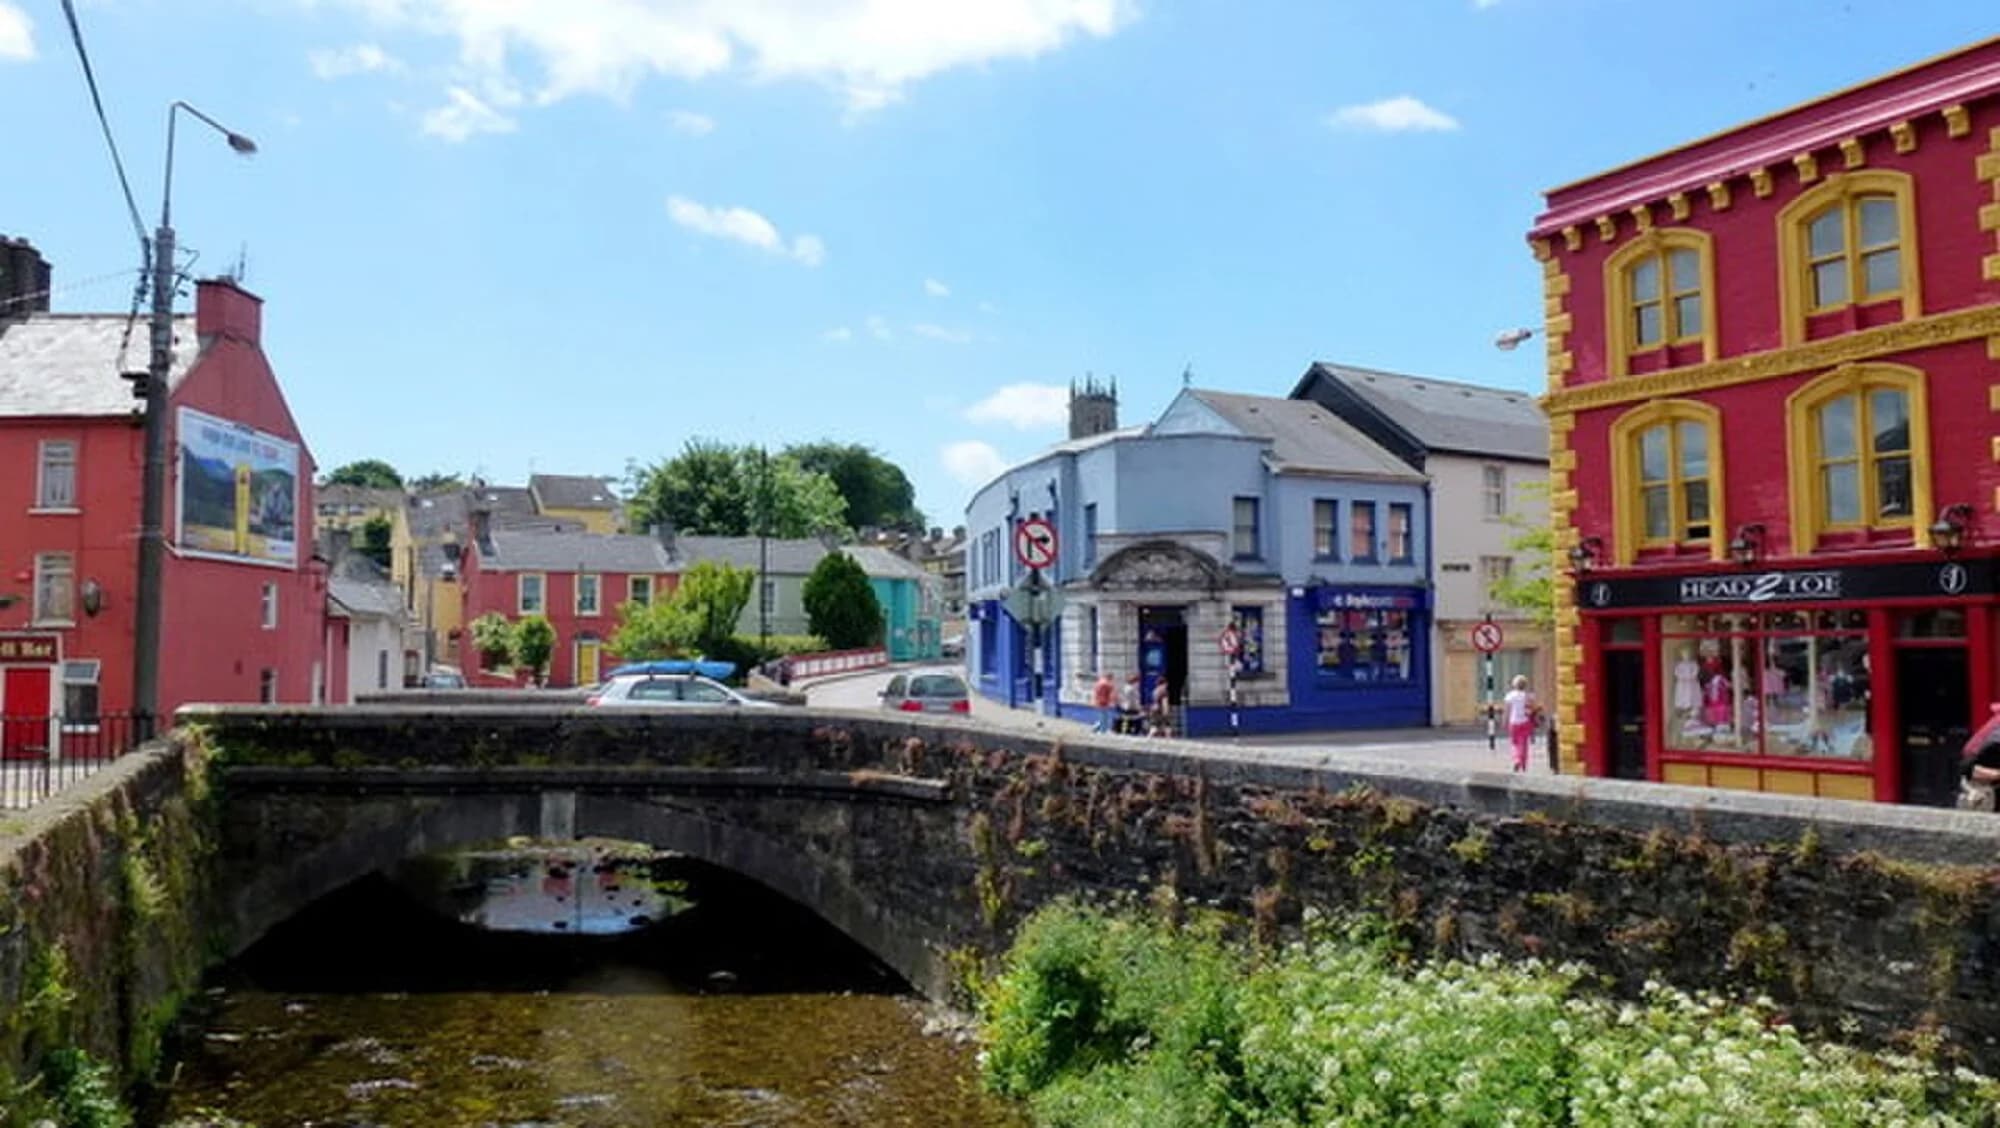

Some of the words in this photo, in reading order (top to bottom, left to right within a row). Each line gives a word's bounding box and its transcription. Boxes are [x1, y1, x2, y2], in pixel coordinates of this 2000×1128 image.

[1680, 582, 1750, 599] HEAD
[1750, 573, 1783, 600] 2
[1786, 575, 1840, 594] TOE
[20, 641, 52, 657] Bar
